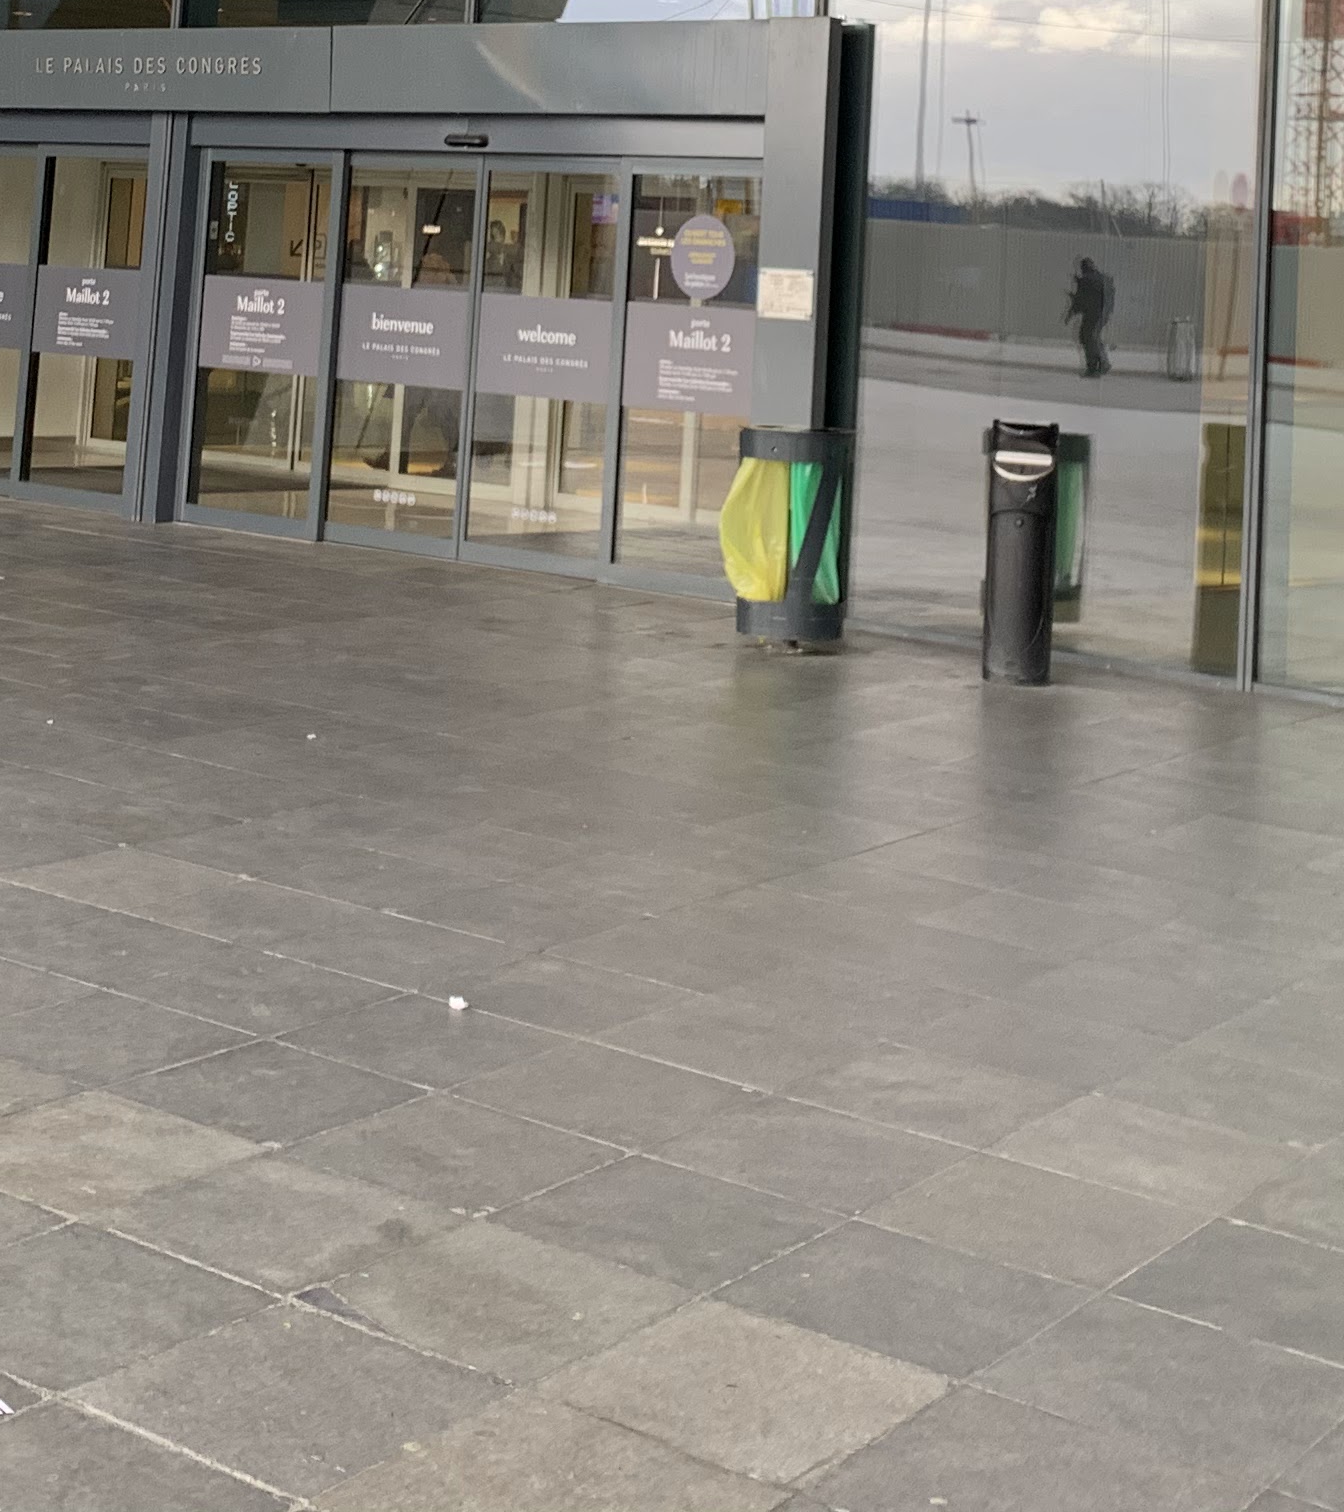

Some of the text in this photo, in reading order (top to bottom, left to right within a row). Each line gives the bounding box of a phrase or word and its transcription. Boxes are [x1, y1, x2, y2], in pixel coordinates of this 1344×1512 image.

[35, 57, 55, 74] LE
[63, 57, 124, 75] PALAIS
[133, 57, 168, 75] DES
[66, 287, 110, 305] Maillot 2
[236, 295, 285, 315] Maillot 2
[371, 312, 434, 335] bienvenue
[518, 324, 577, 346] welcome
[669, 329, 731, 353] Maillot 2
